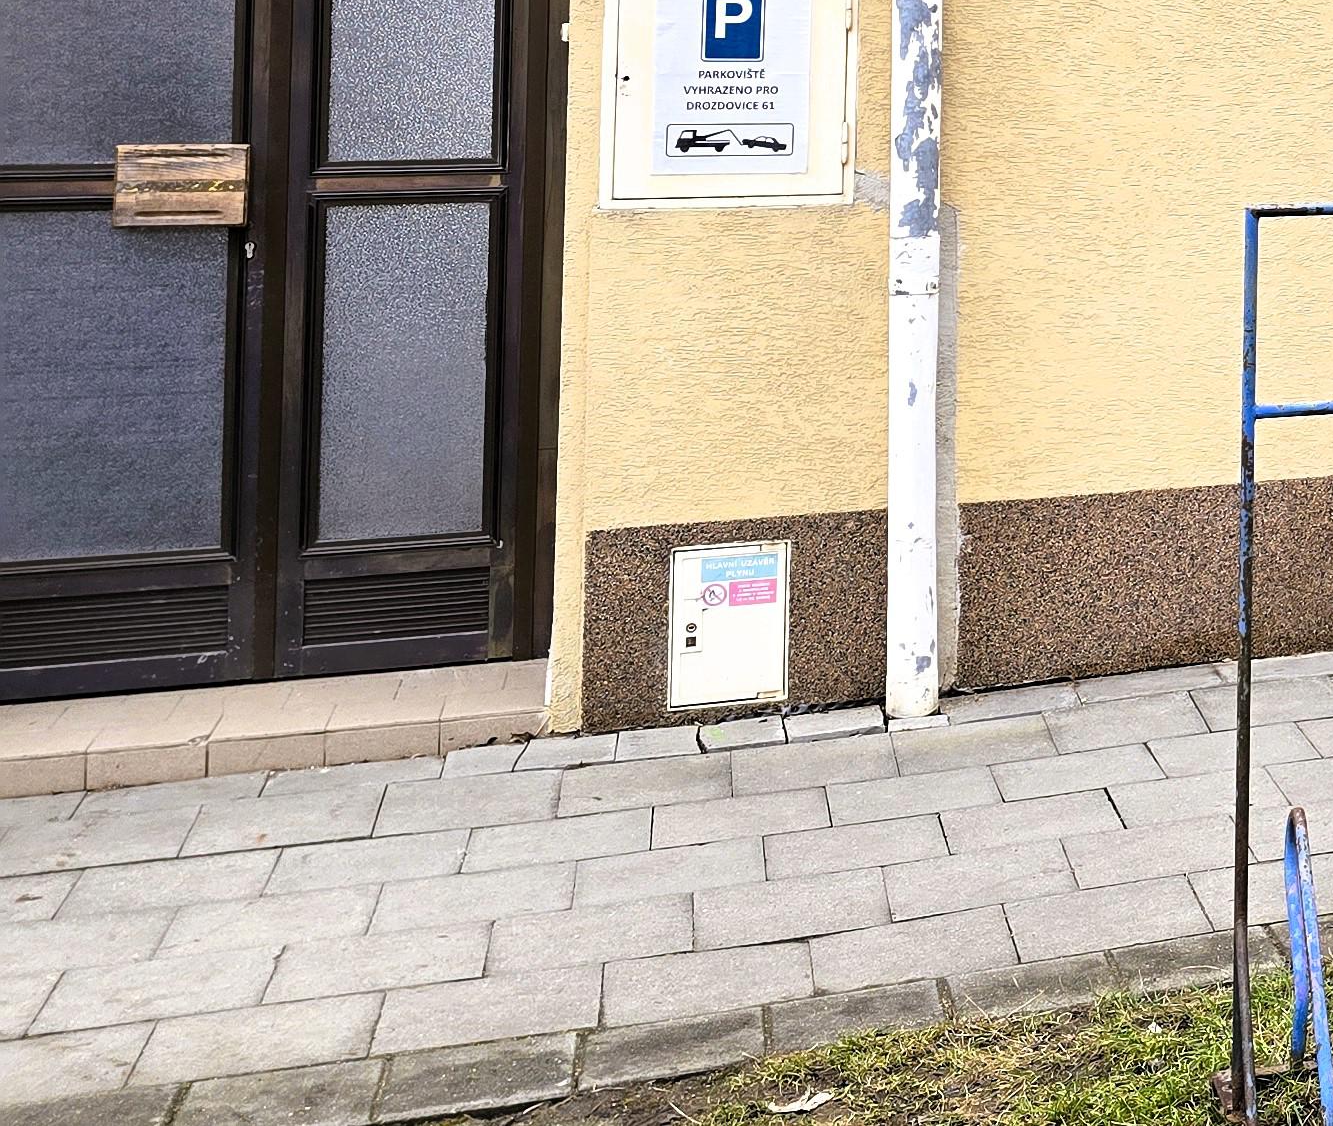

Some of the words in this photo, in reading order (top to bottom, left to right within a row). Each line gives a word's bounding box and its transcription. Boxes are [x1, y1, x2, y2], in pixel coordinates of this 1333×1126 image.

[698, 67, 766, 79] PARKOVIŠTĚ
[683, 85, 753, 94] VYHRAZENO
[755, 85, 779, 95] PRO
[686, 101, 759, 110] DROZDOVICE
[762, 101, 775, 110] 61
